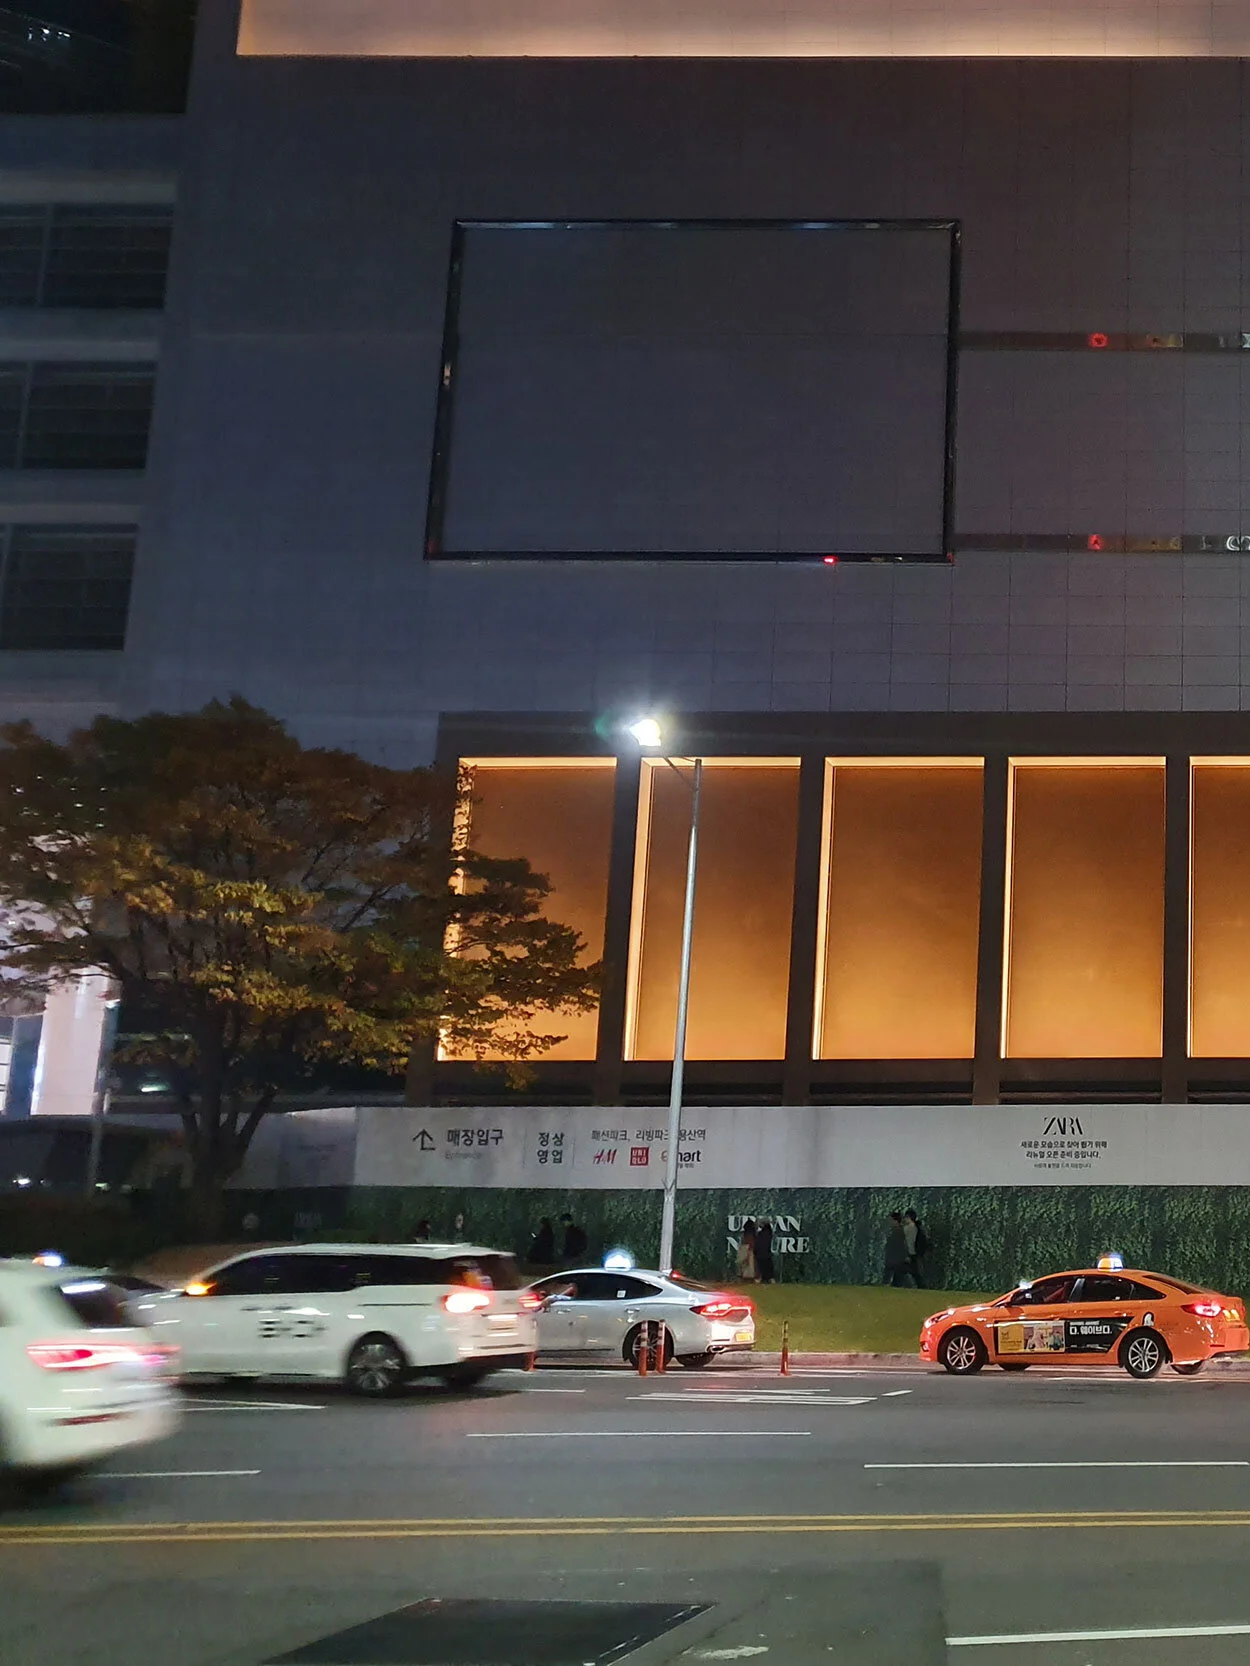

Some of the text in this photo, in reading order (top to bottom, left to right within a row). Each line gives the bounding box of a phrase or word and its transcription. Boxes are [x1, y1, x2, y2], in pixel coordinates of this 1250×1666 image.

[1043, 1117, 1083, 1135] ZARA
[447, 1129, 504, 1146] 매장입구
[538, 1132, 565, 1147] 정상
[537, 1149, 563, 1164] 영업
[661, 1149, 701, 1163] eart
[728, 1215, 802, 1231] URAN
[727, 1236, 809, 1253] NURE
